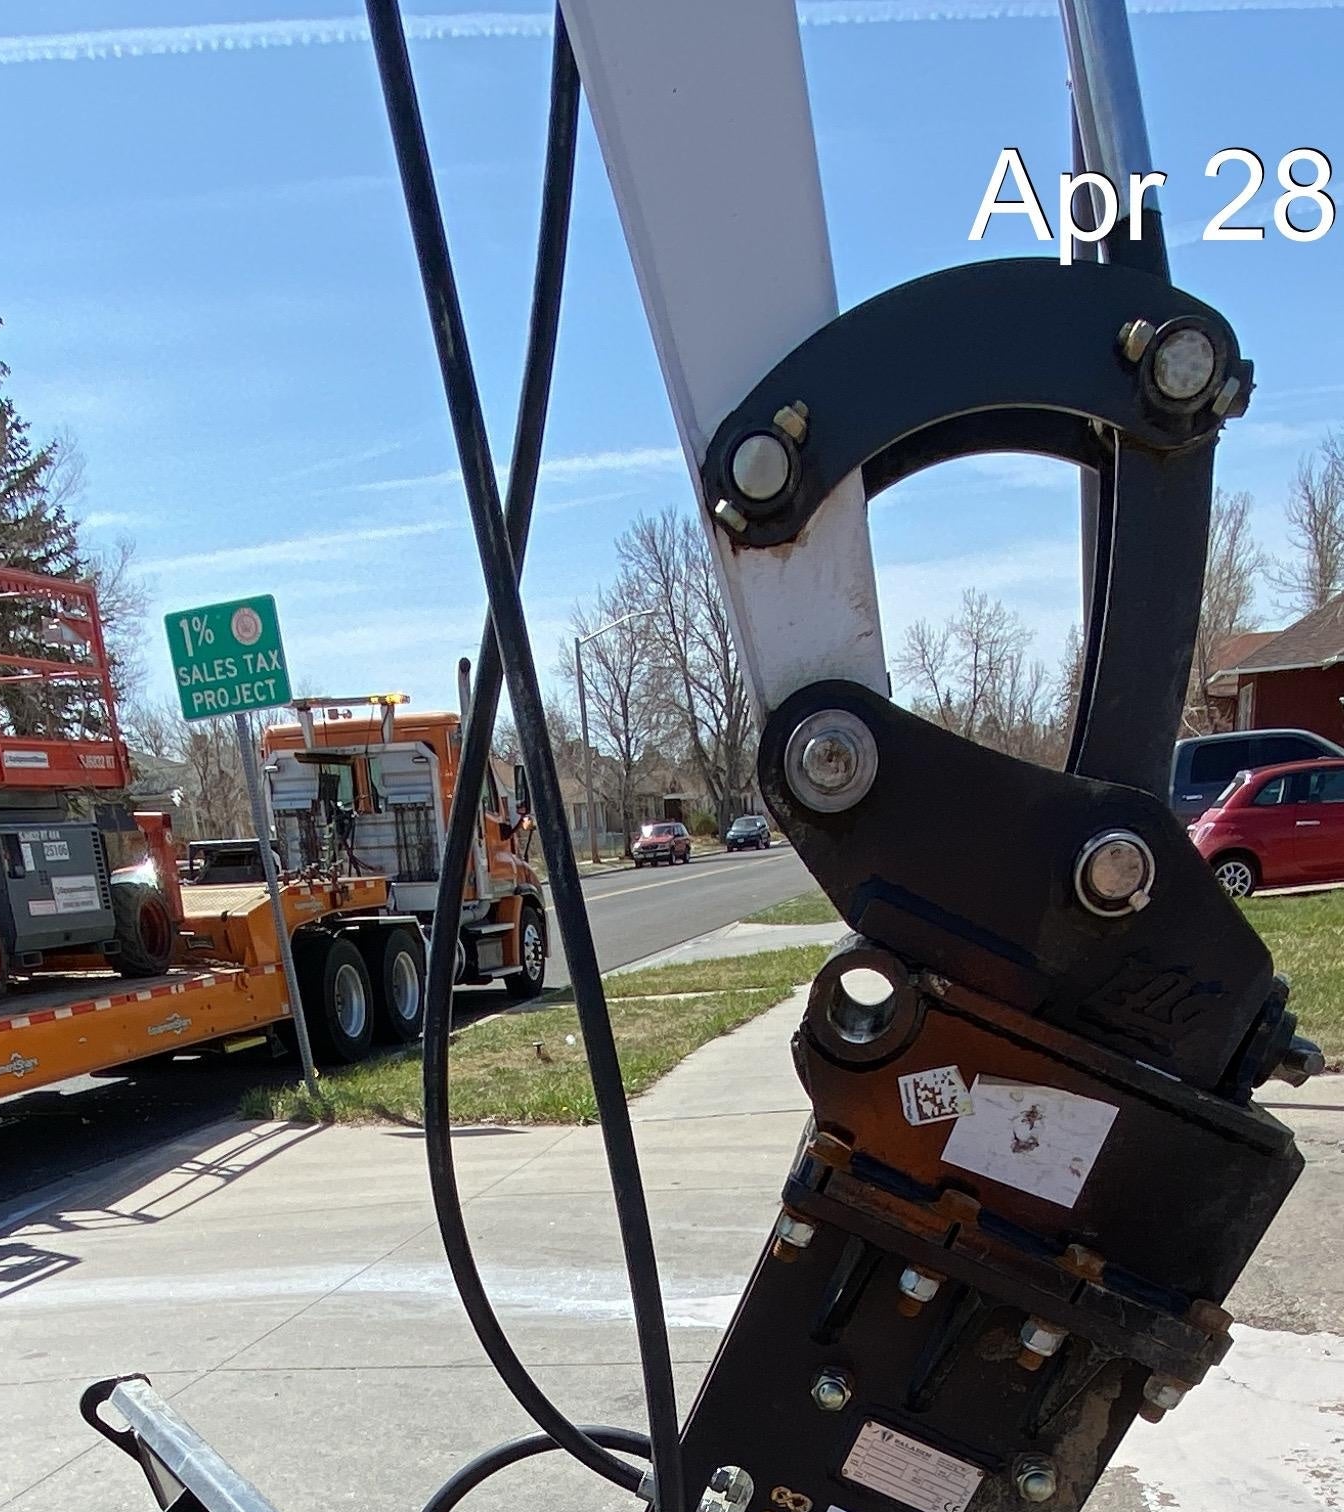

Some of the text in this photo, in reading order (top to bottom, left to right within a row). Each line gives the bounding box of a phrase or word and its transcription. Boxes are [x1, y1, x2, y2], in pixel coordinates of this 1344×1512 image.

[179, 614, 215, 657] 1%
[178, 649, 282, 687] SALES TAX
[191, 679, 276, 713] PROJECT
